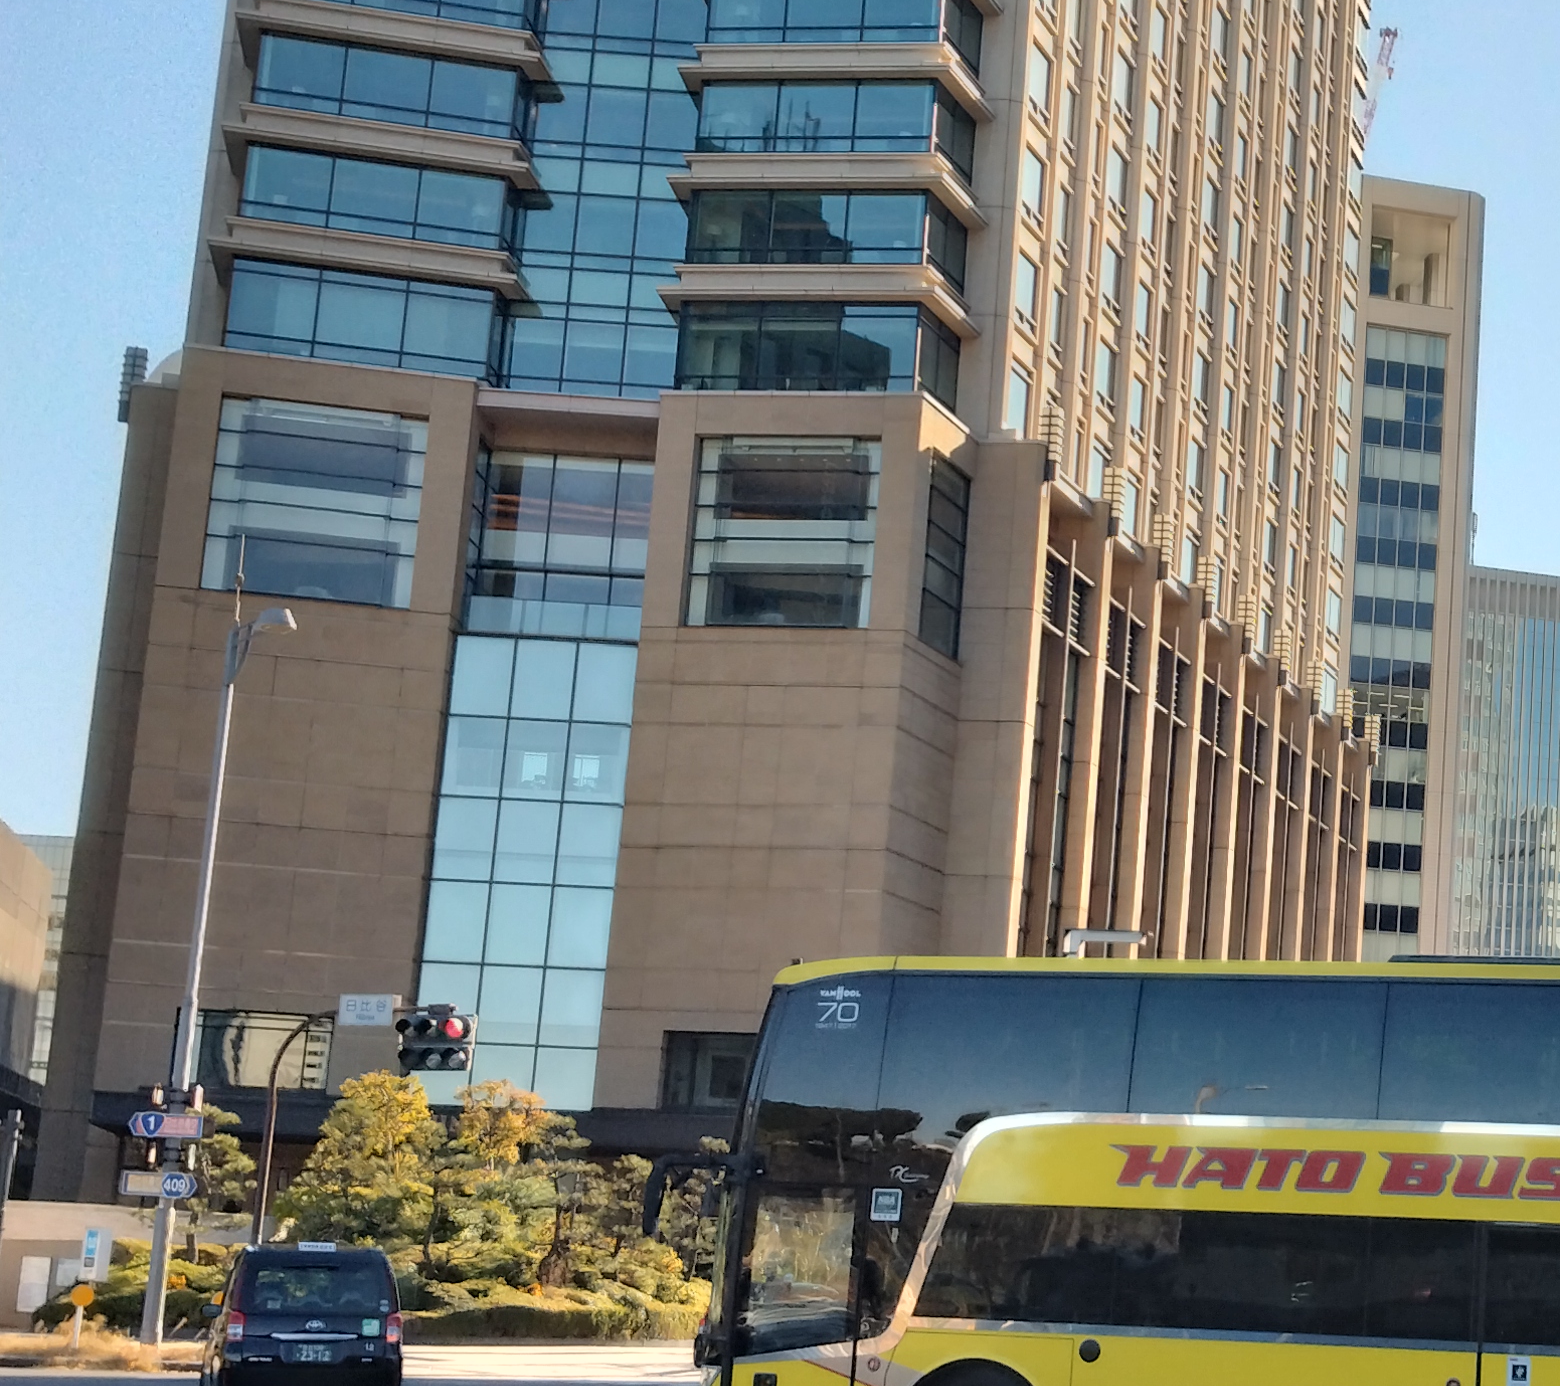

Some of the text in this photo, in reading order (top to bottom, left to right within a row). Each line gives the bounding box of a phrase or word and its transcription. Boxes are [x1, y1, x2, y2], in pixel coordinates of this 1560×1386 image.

[346, 999, 387, 1012] 日比谷
[817, 1002, 860, 1022] 70
[147, 1115, 155, 1131] 1
[1109, 1144, 1366, 1193] HATO
[163, 1178, 186, 1192] 409
